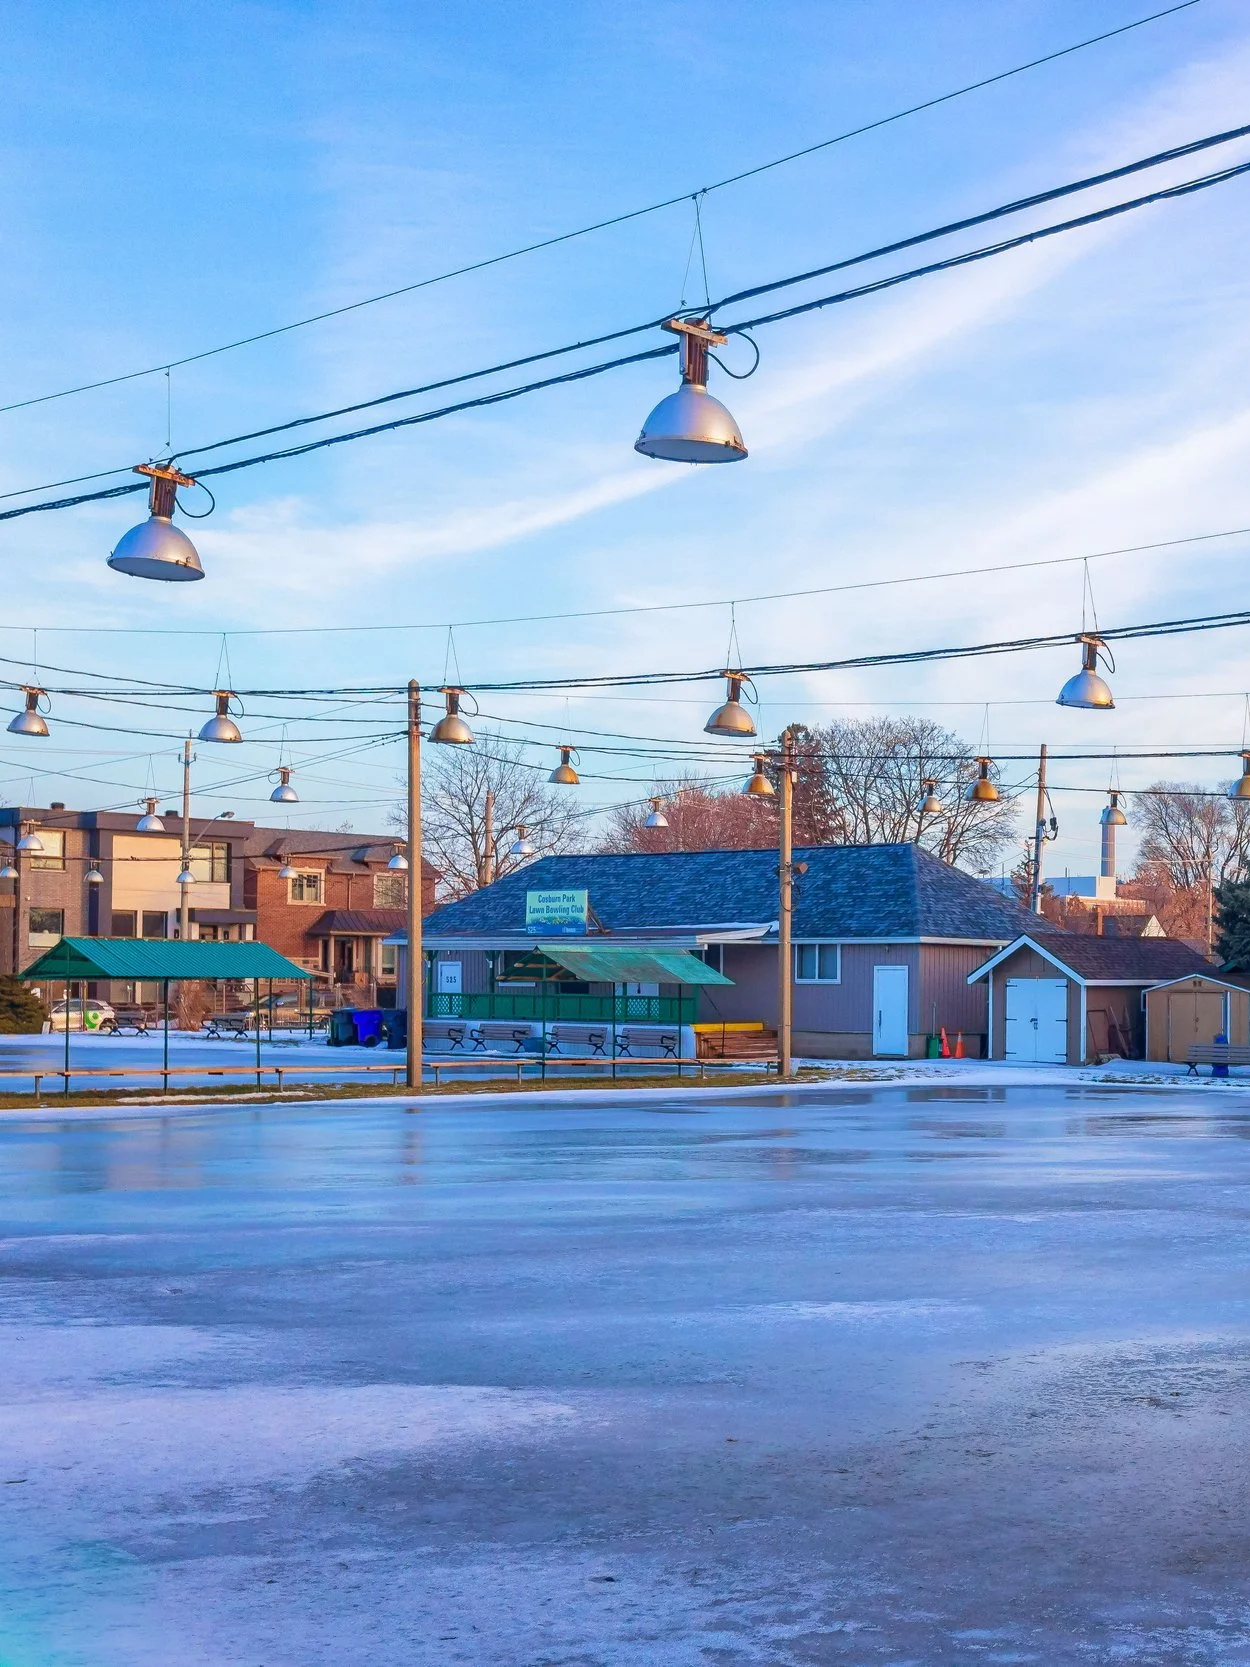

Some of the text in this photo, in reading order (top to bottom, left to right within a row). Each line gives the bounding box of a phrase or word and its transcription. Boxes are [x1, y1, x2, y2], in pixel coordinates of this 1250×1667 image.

[538, 894, 575, 903] Cosburn Park
[529, 905, 584, 915] Lawn Bowling Club
